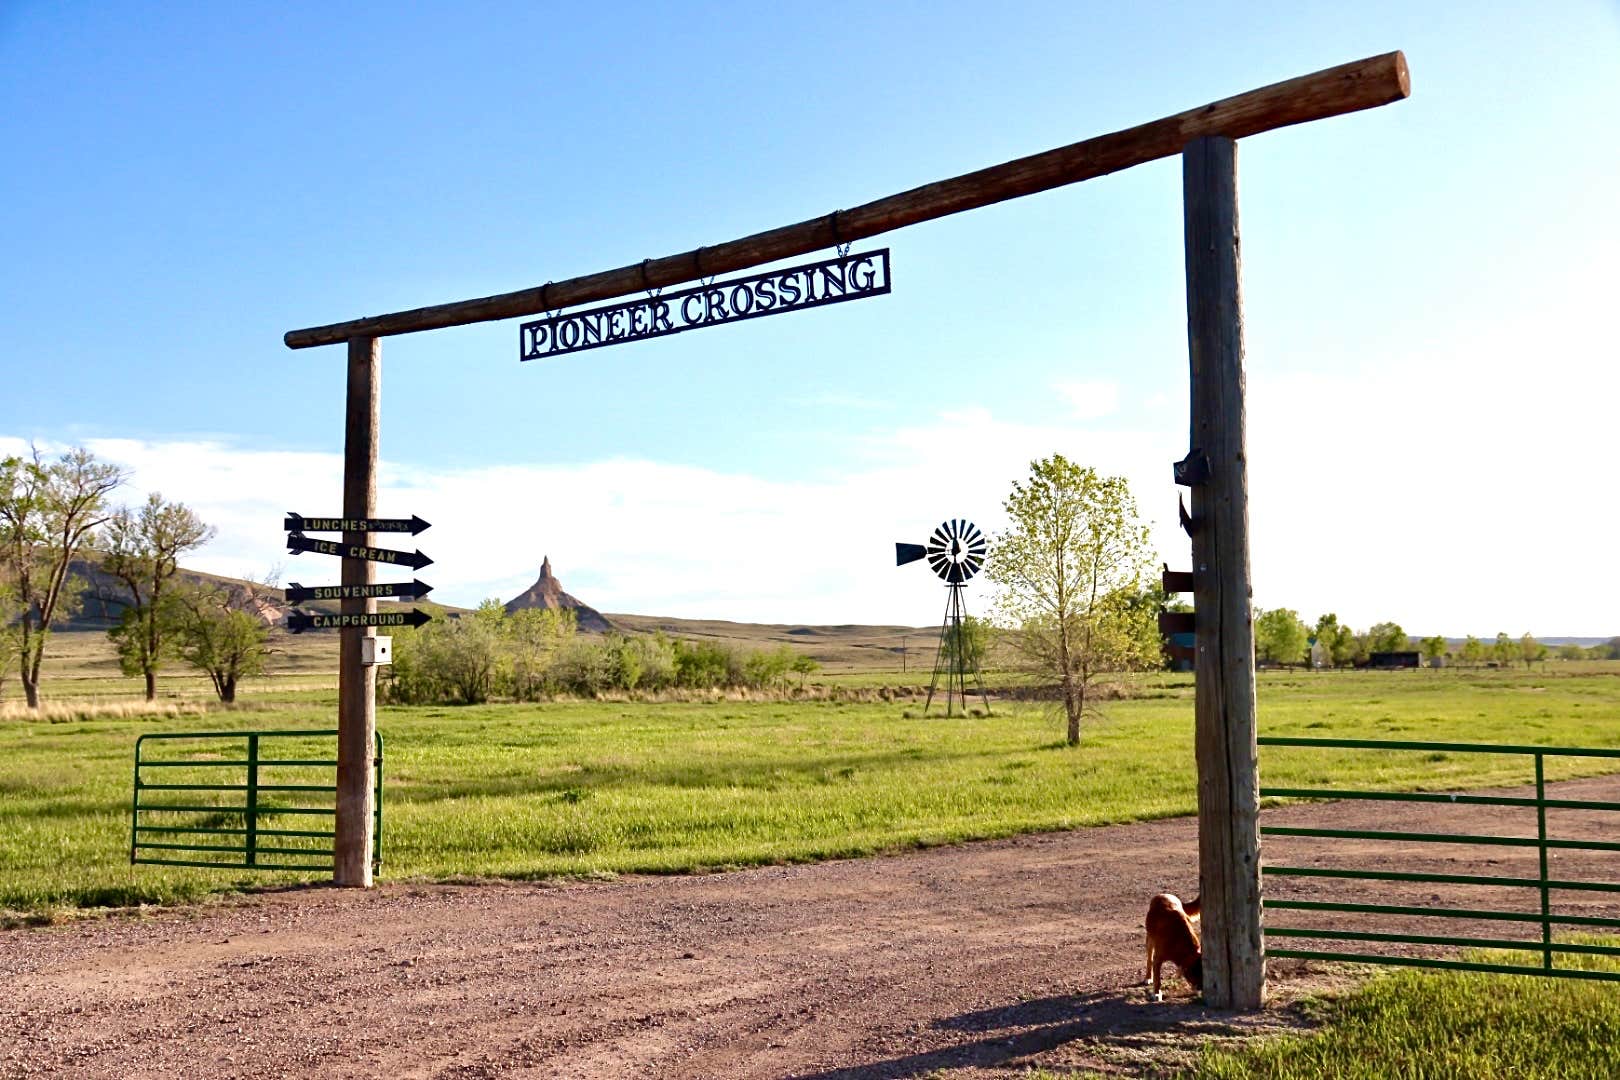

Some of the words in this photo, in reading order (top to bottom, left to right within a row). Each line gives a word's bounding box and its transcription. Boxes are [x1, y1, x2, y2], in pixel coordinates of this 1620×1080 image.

[529, 297, 674, 355] PIONEER
[680, 258, 876, 326] CROSSING
[303, 519, 367, 531] LUNCHES
[314, 541, 337, 554] ICE
[350, 547, 397, 563] CREAM
[314, 585, 393, 599] SOUVENIRS
[313, 614, 405, 627] CAMPGROUND
